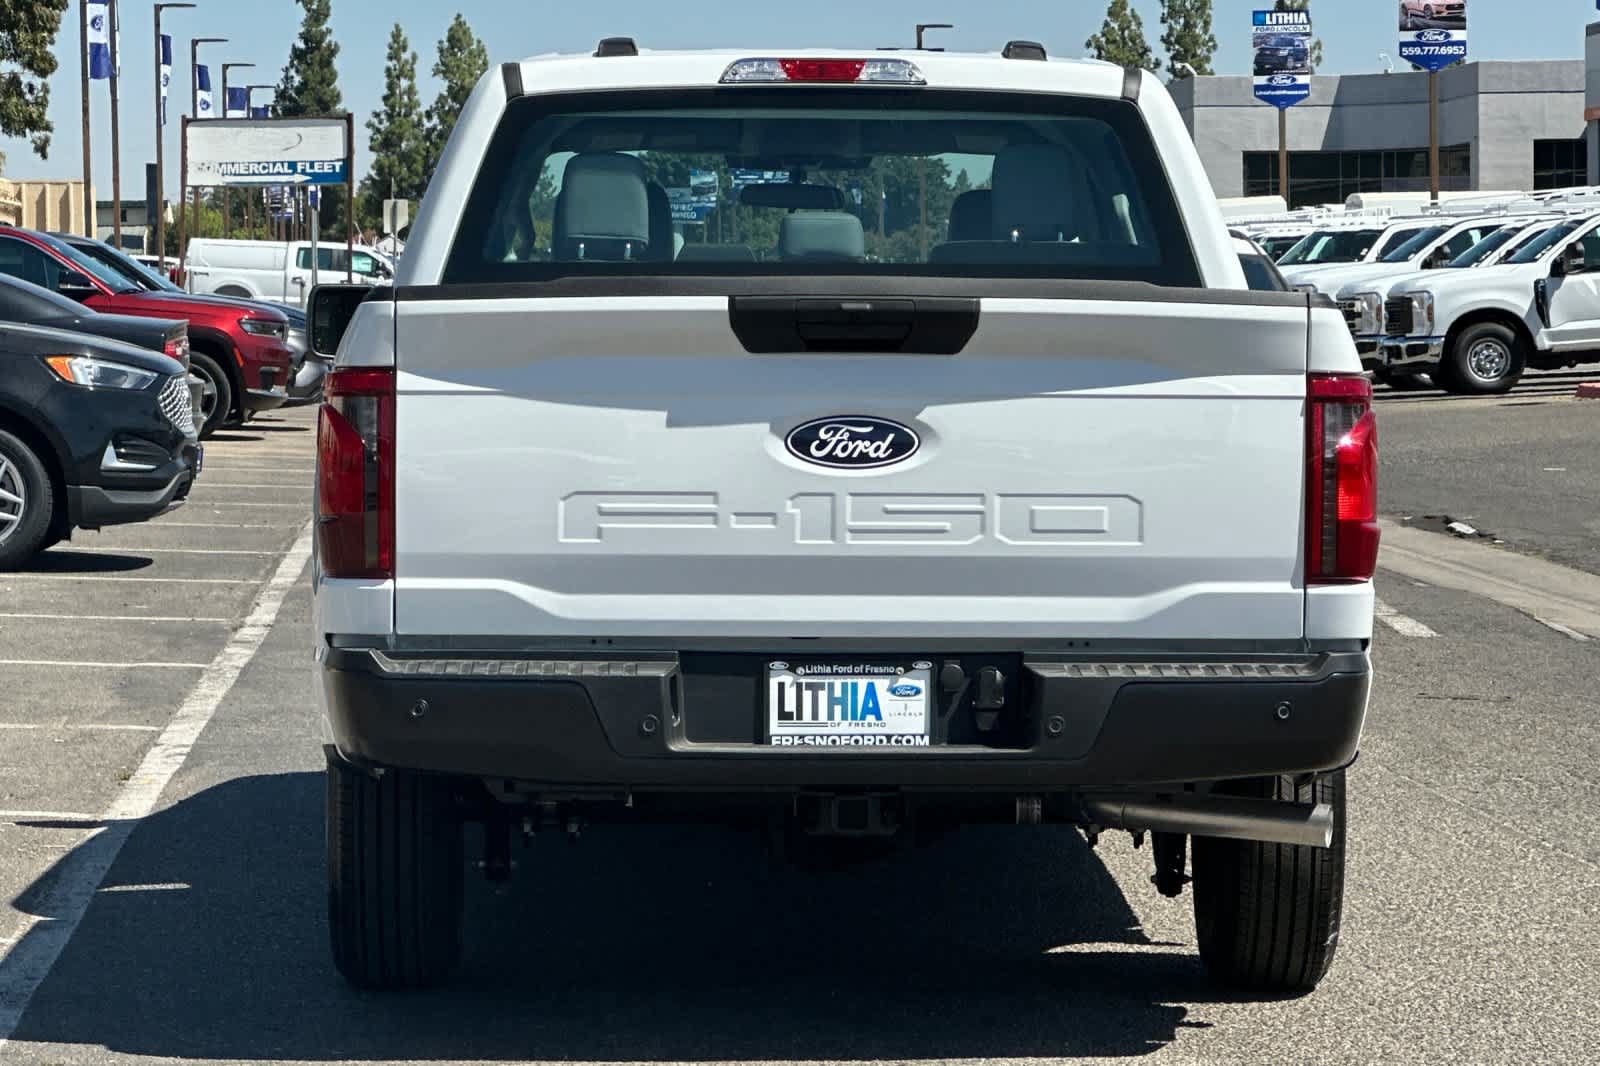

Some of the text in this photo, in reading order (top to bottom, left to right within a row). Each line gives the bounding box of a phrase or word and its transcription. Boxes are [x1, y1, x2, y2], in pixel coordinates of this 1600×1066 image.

[1265, 12, 1308, 25] LITHIA
[1401, 45, 1465, 56] 559.777.6952
[196, 160, 343, 175] MMERCIAL FLEET
[557, 490, 1145, 546] F-150
[805, 664, 896, 674] Lithia Ford of Fresno
[777, 681, 883, 721] LITHIA
